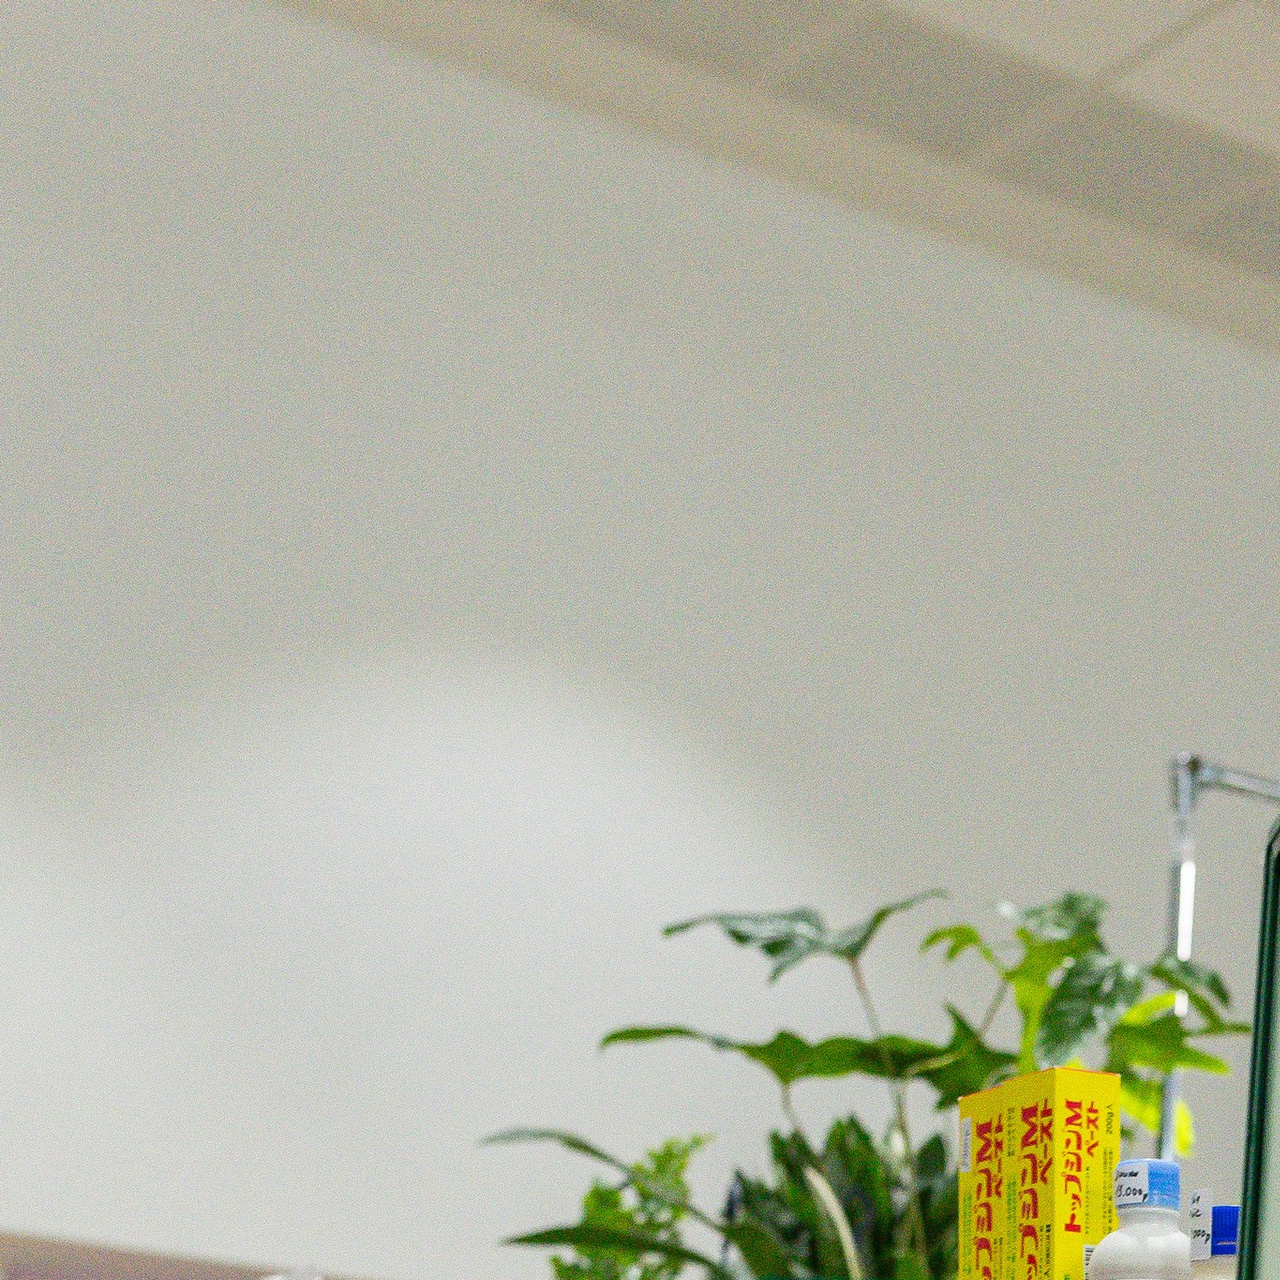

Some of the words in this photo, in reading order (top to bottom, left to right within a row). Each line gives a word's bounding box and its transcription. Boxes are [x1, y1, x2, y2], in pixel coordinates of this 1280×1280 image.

[1039, 1097, 1054, 1185] ペースト
[1061, 1099, 1084, 1234] トップジンM
[1086, 1100, 1100, 1158] ペースト
